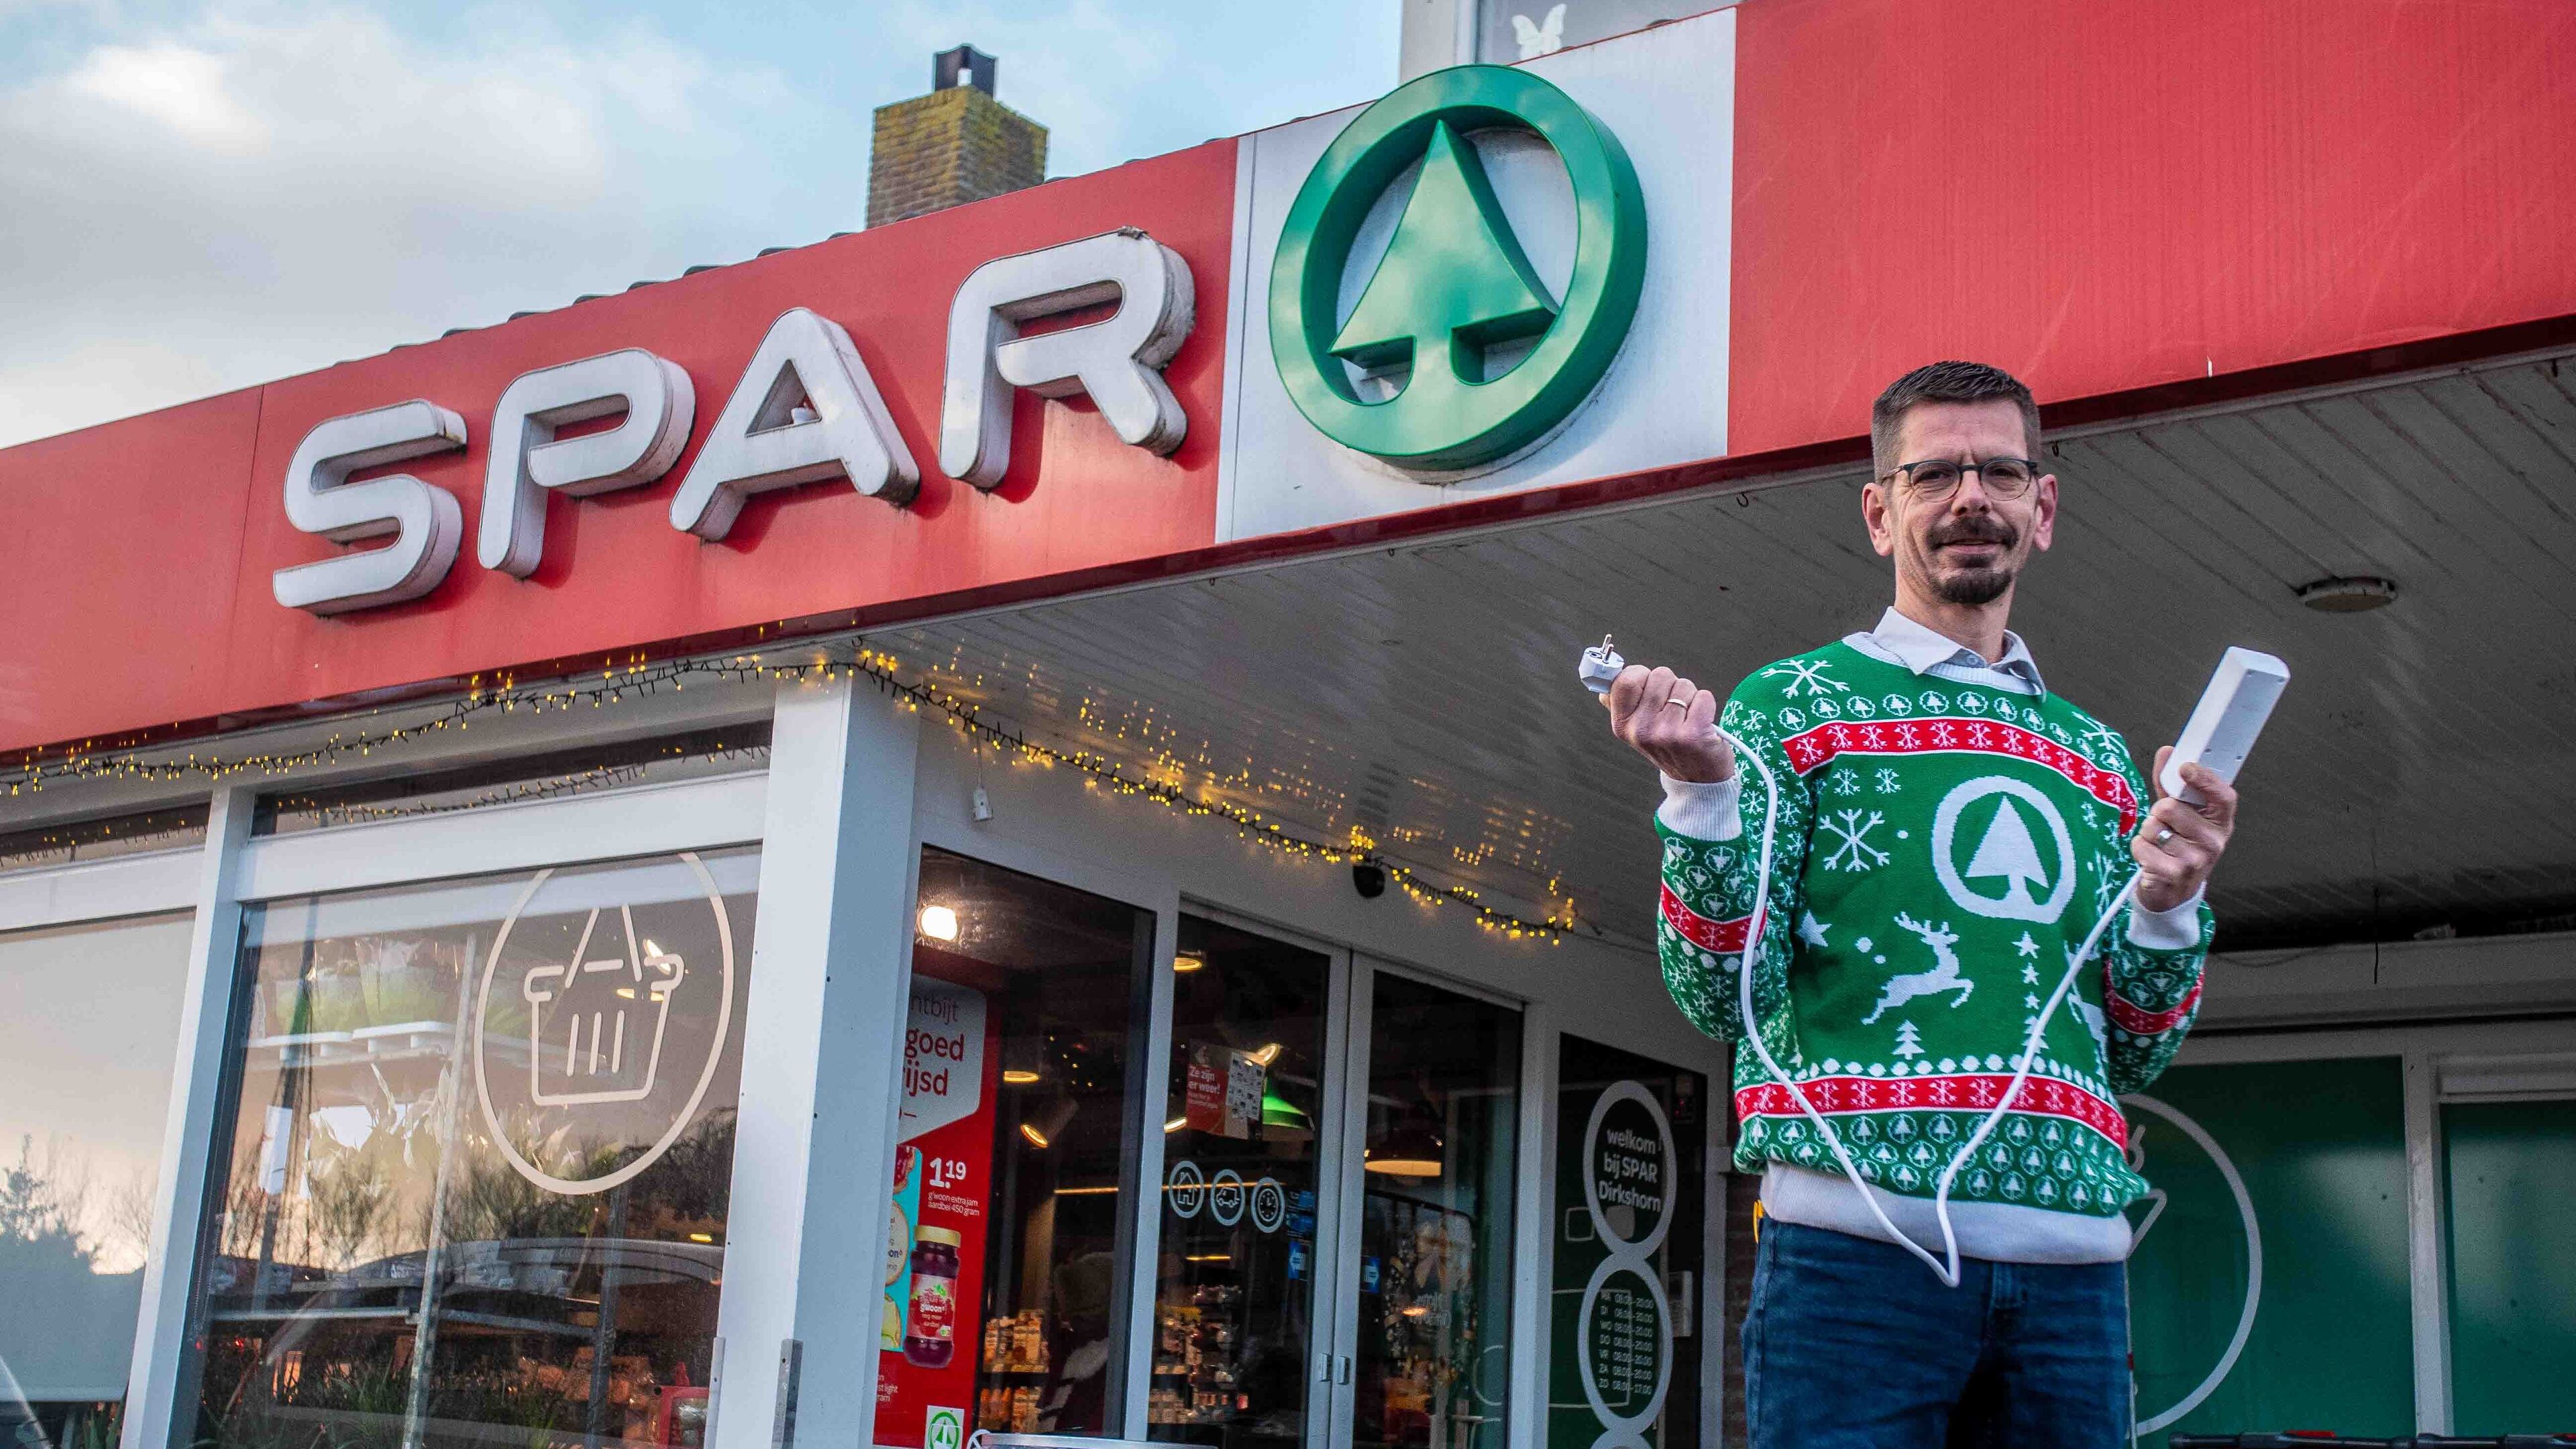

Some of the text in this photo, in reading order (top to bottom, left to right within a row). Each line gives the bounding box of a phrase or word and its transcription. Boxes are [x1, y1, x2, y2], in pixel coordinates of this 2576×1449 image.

[274, 229, 1195, 615] SPAR
[911, 989, 959, 1025] ntbijt
[905, 1028, 965, 1061] goed
[904, 1059, 949, 1097] ijsd
[1607, 1128, 1656, 1154] welkom
[1604, 1152, 1658, 1183] bij SPAR
[1599, 1180, 1661, 1213] Dirkshorn
